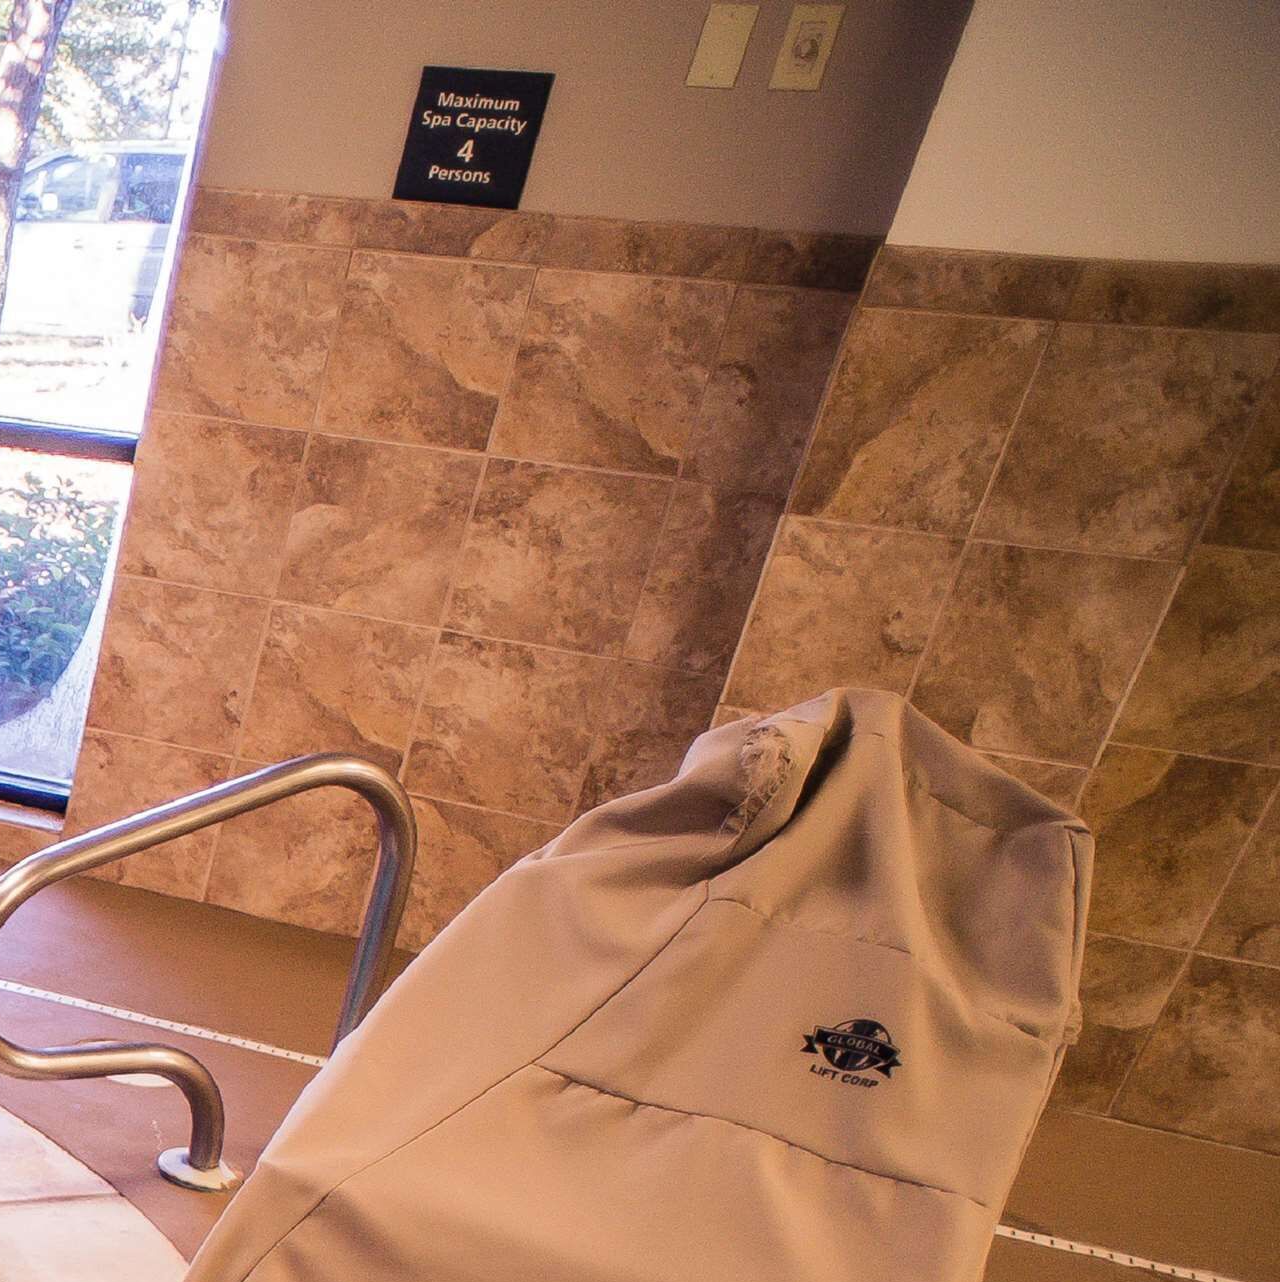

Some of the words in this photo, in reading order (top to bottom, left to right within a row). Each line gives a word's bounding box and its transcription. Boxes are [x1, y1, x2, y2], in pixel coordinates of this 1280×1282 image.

[438, 92, 520, 111] Maximum
[422, 110, 451, 128] Spa
[456, 113, 527, 135] Capacity
[456, 139, 475, 163] 4
[428, 164, 491, 184] Persons
[827, 1034, 880, 1054] GLOBAL
[810, 1065, 839, 1080] LIFT
[842, 1073, 878, 1088] CORP
